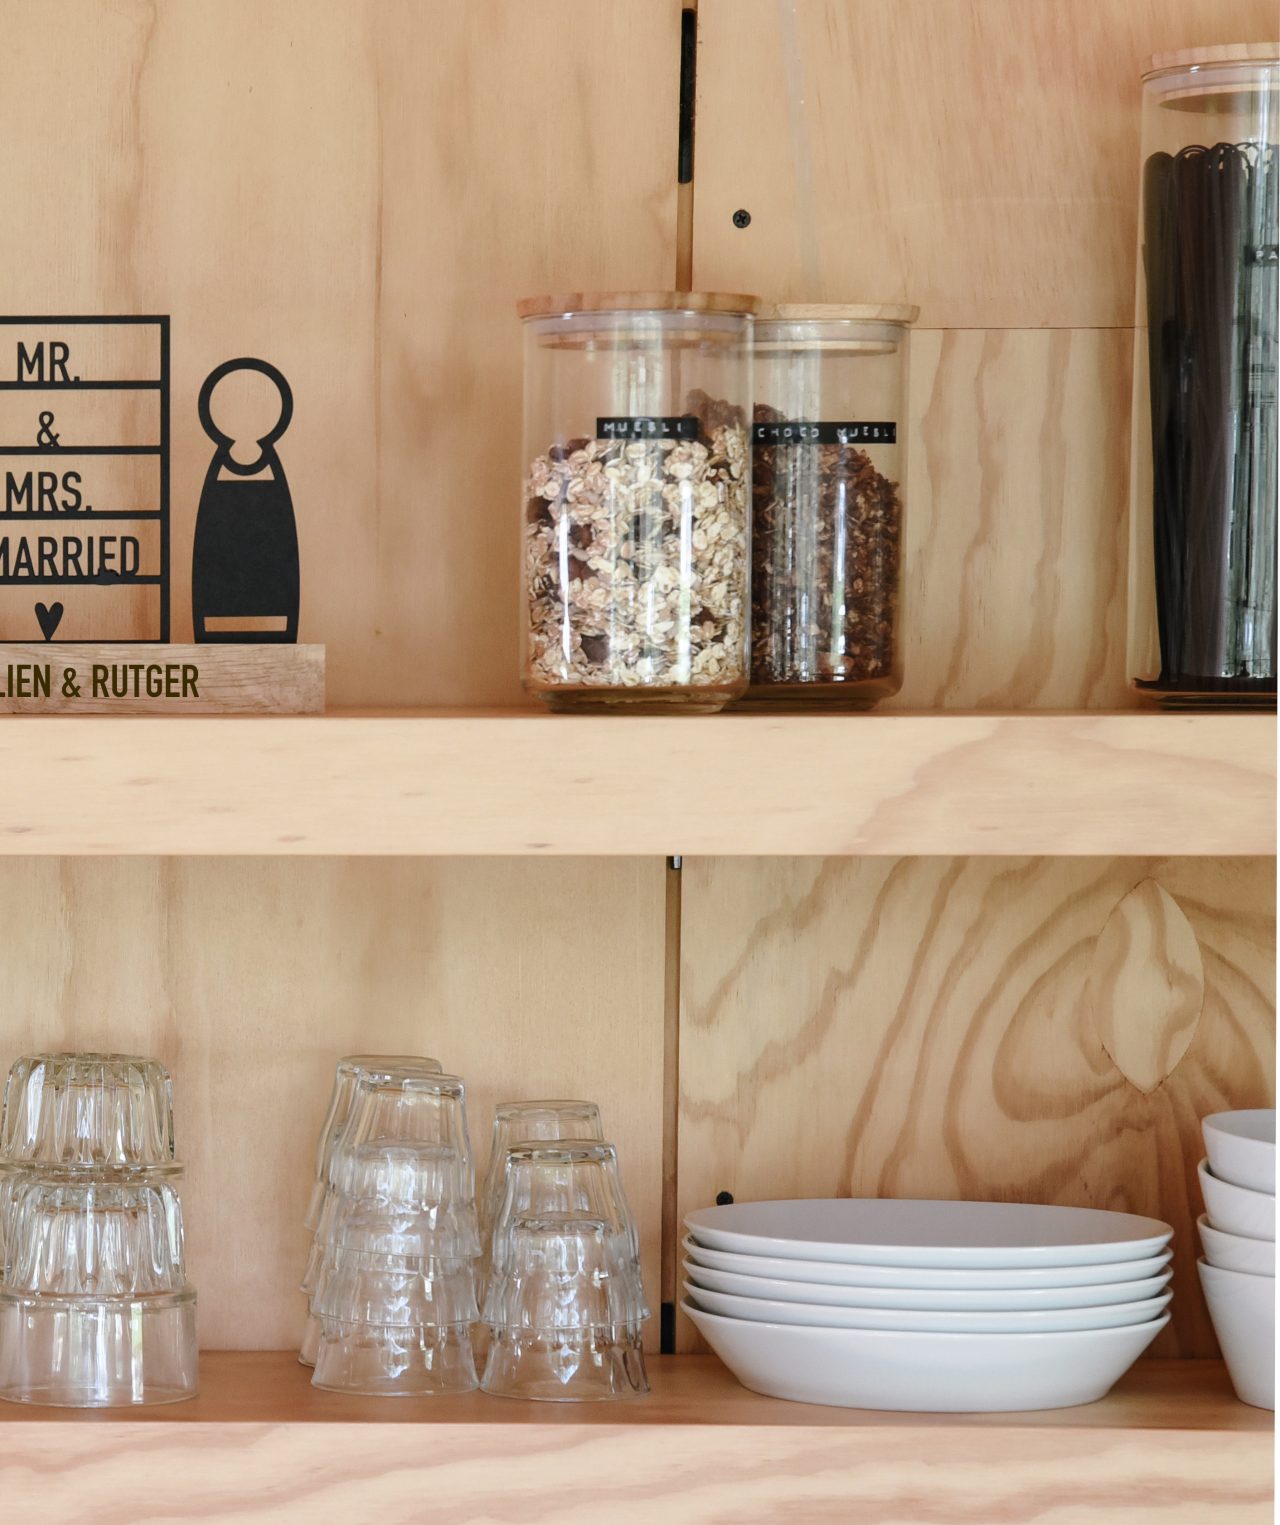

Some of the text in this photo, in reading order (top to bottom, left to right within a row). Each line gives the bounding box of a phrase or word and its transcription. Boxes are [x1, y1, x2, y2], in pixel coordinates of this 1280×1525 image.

[16, 341, 80, 382] MR.
[36, 411, 60, 447] &
[603, 421, 683, 433] MUESLI
[757, 426, 896, 440] CHOCO MUESLI
[6, 471, 92, 512] MRS.
[61, 667, 81, 698] &
[92, 664, 200, 698] RUTGER
